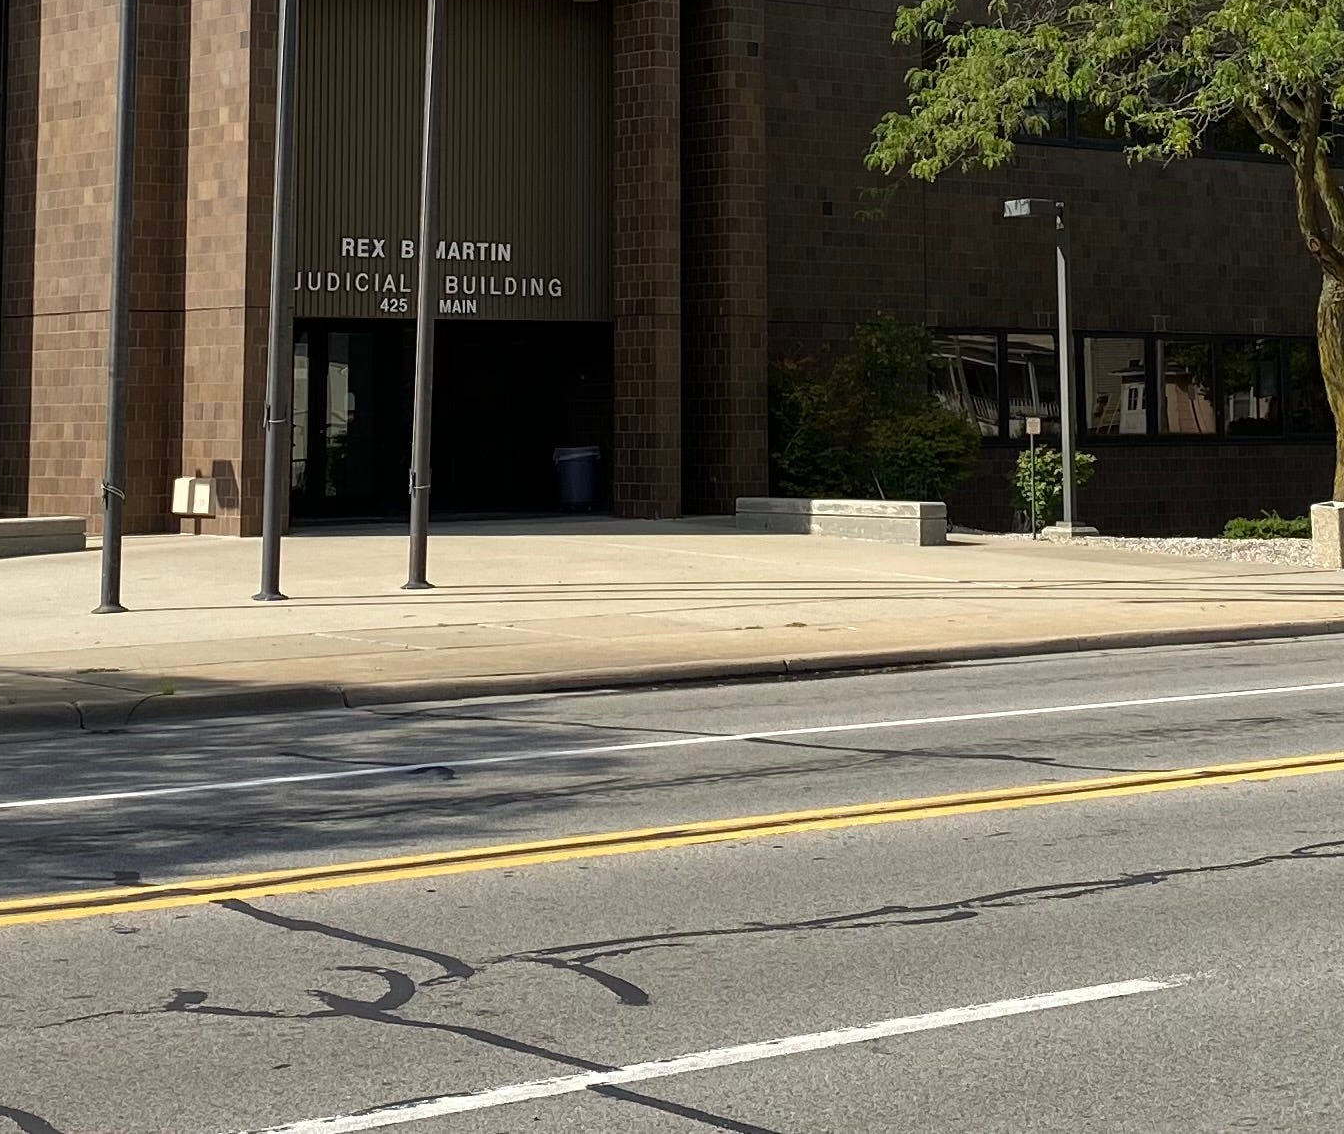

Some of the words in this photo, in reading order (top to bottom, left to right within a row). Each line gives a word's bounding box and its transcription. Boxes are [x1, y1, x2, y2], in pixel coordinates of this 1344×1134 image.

[341, 237, 386, 258] REX
[401, 239, 415, 259] B
[435, 240, 512, 262] MARTIN
[293, 271, 412, 293] JUDICIAL
[445, 275, 563, 297] BUILDING
[379, 297, 408, 312] 425
[439, 299, 477, 314] MAIN
